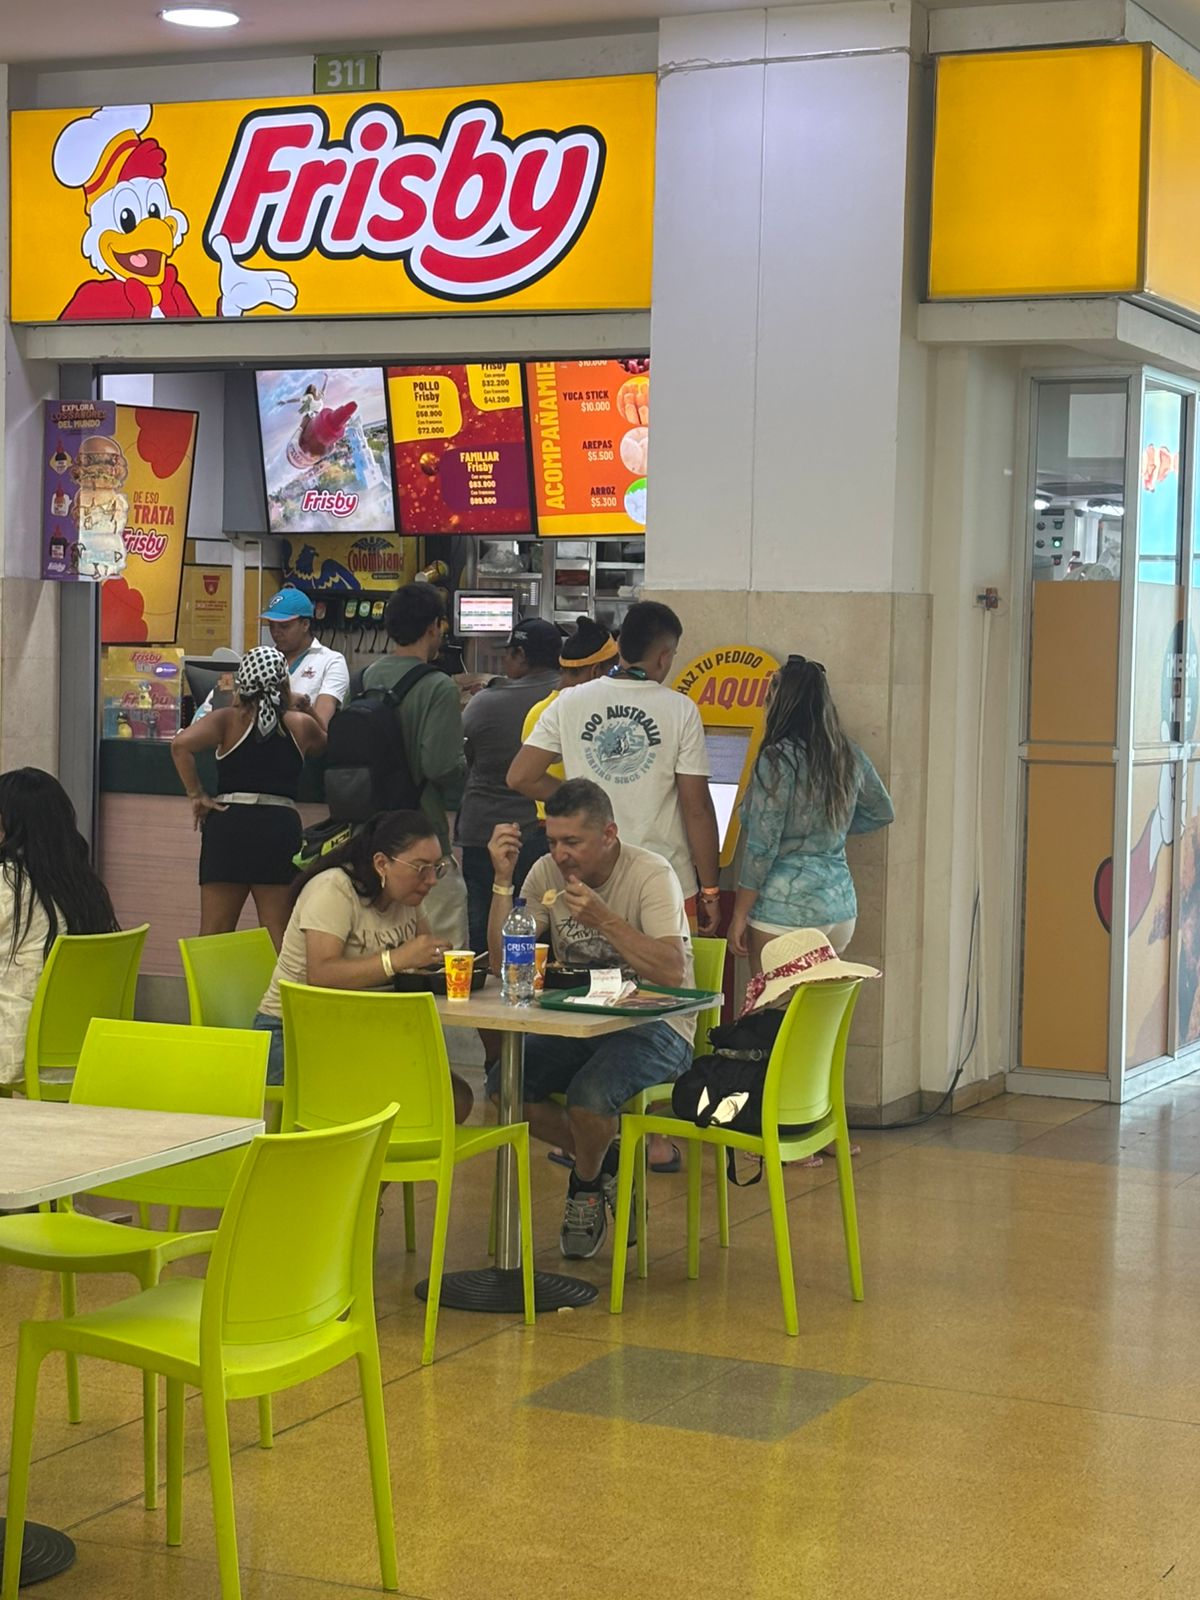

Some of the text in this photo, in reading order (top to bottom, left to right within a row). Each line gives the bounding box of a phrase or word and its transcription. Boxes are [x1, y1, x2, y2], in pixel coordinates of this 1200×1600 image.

[326, 59, 366, 87] 311
[212, 108, 598, 298] Frisby
[413, 381, 439, 391] POLLO
[414, 391, 440, 402] Frisby
[563, 390, 609, 401] YUCA STICK
[581, 401, 610, 412] $10.000
[58, 419, 101, 429] DEL MUNDO
[582, 440, 612, 450] AREPAS
[460, 451, 500, 462] FAMILIAR
[588, 451, 614, 462] $5.500
[467, 462, 493, 474] Frisby
[590, 486, 616, 496] ARROZ
[134, 491, 159, 504] DE ESO
[591, 496, 617, 508] $5.300
[302, 490, 359, 518] Frisby
[134, 504, 174, 525] TRATA
[677, 650, 763, 696] HAZ TU PEDIDO
[698, 671, 774, 710] AQUÍ
[581, 704, 662, 748] DOO AUSTRALIA
[614, 774, 640, 784] SINCE
